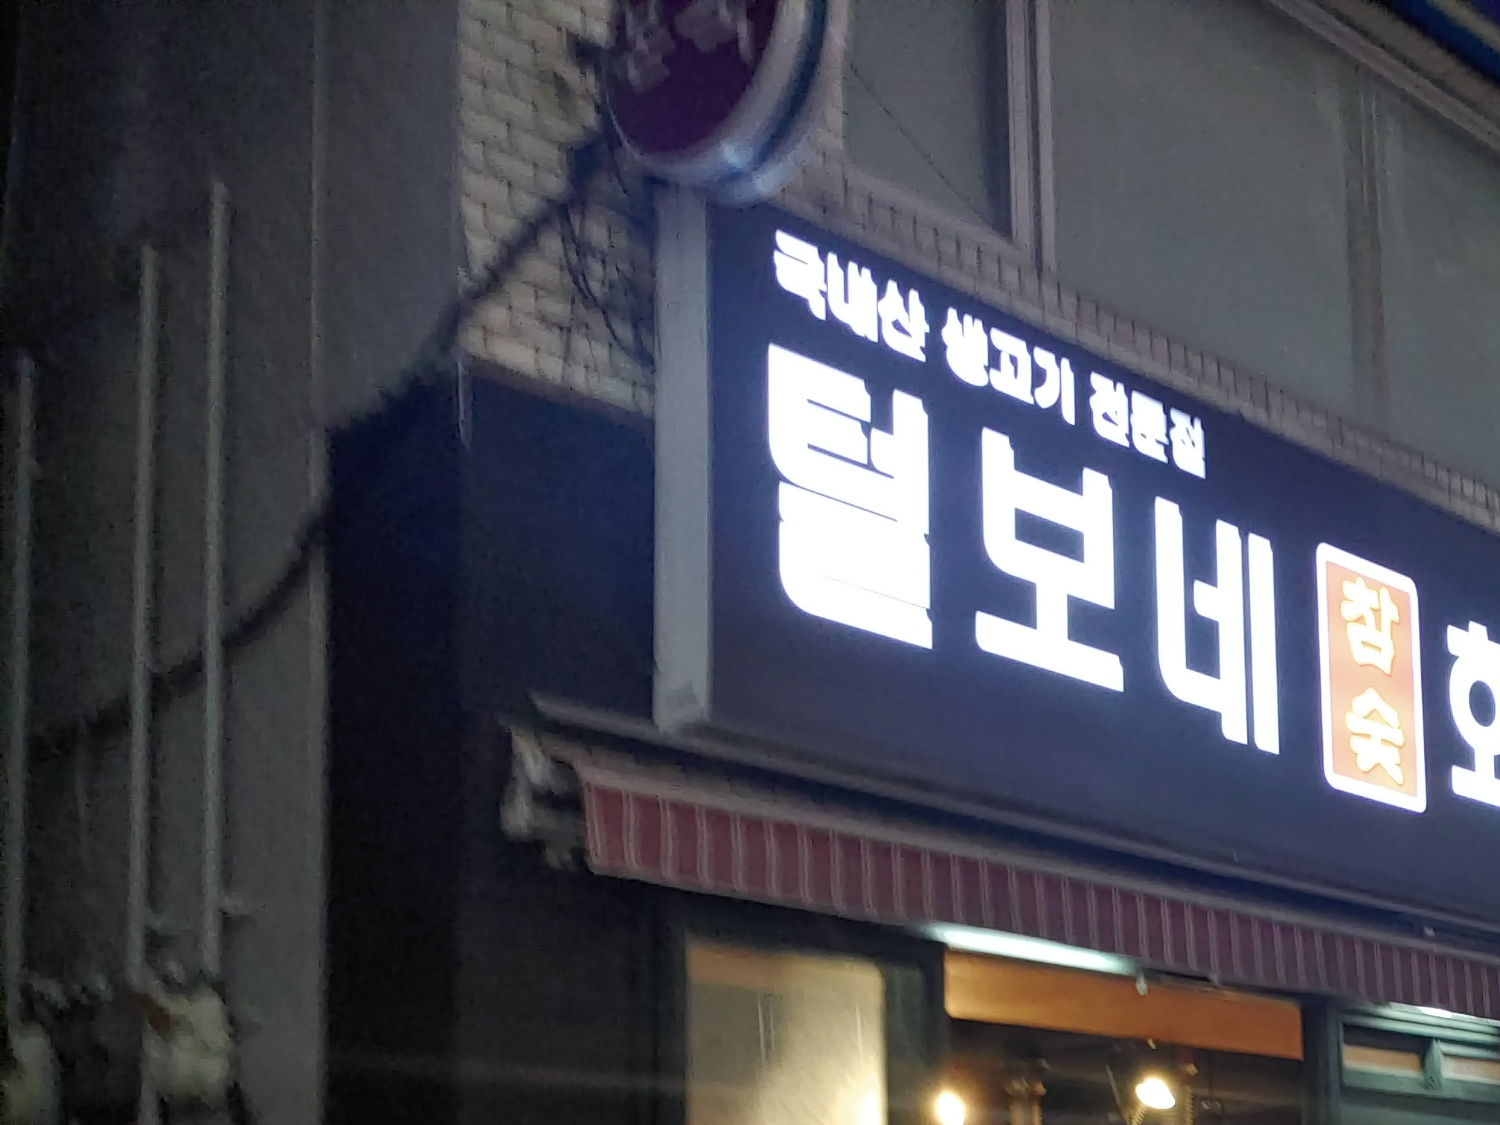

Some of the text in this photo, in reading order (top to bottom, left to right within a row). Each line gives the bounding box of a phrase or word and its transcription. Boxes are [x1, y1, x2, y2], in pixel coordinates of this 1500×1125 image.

[773, 229, 1207, 479] 국내산 생고기 전문점
[768, 343, 1280, 755] 털보네
[1341, 577, 1405, 786] 참숯
